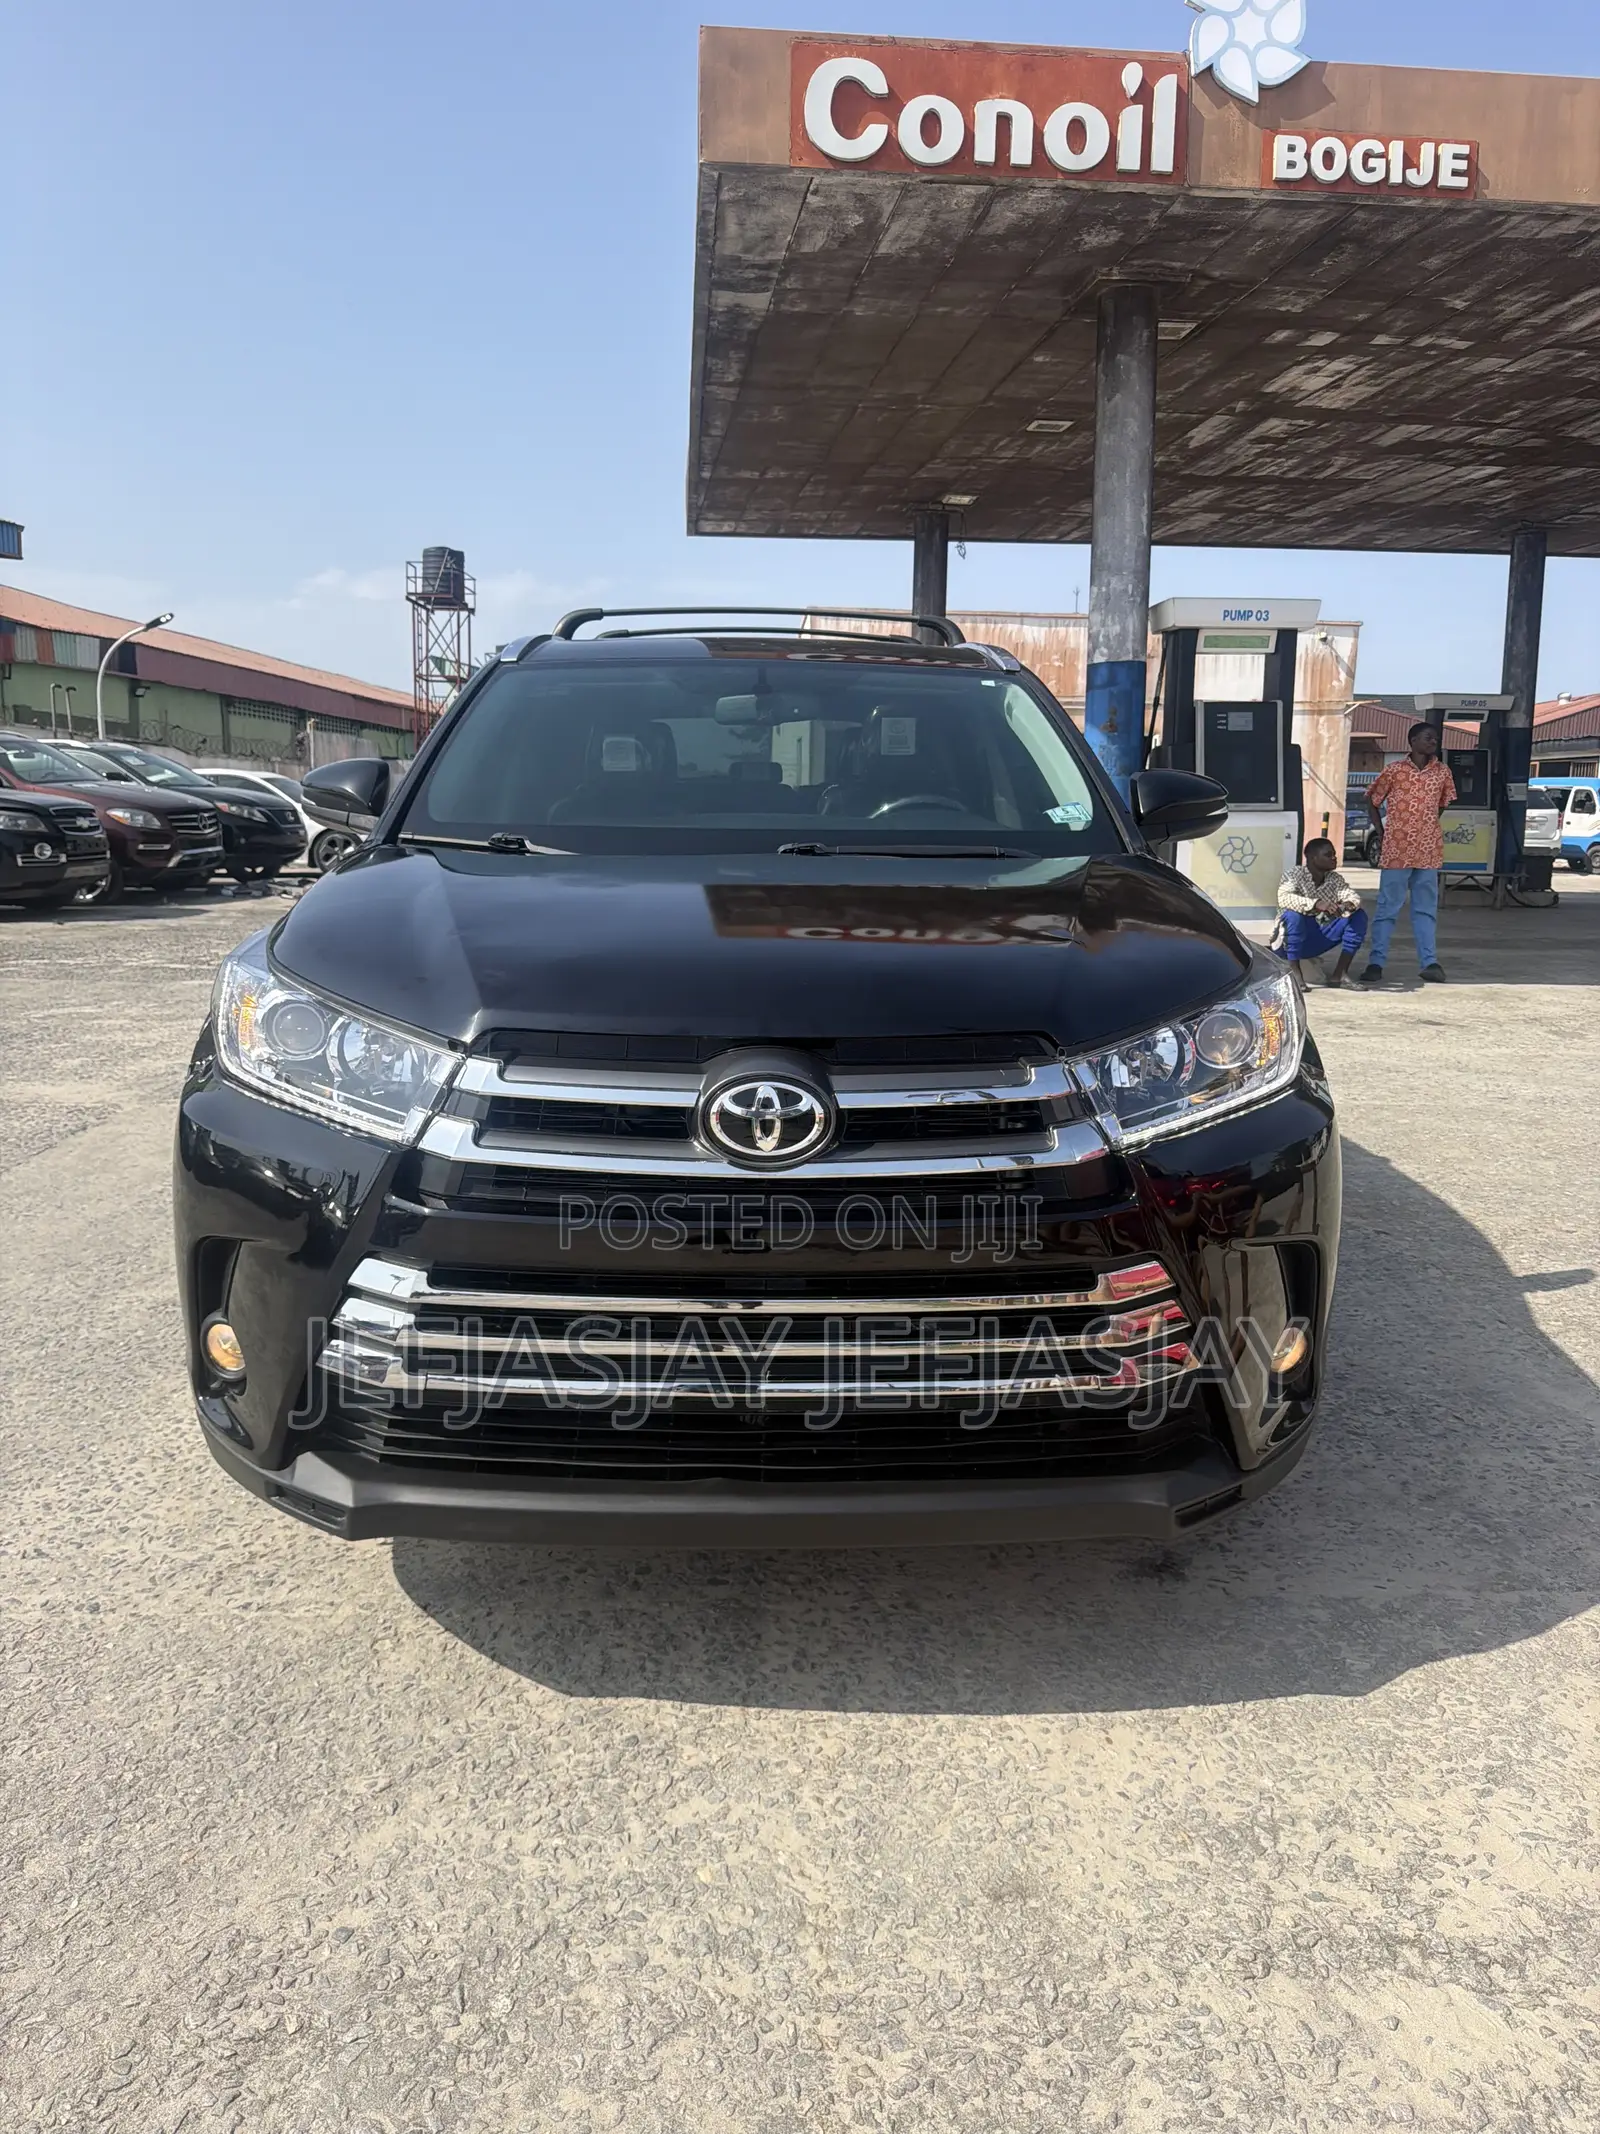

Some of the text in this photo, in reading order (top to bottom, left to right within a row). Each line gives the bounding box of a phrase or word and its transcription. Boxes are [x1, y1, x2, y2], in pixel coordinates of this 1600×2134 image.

[804, 57, 1178, 175] Conoil
[1273, 134, 1471, 190] BOGIJE
[1222, 609, 1270, 621] PUMP 03
